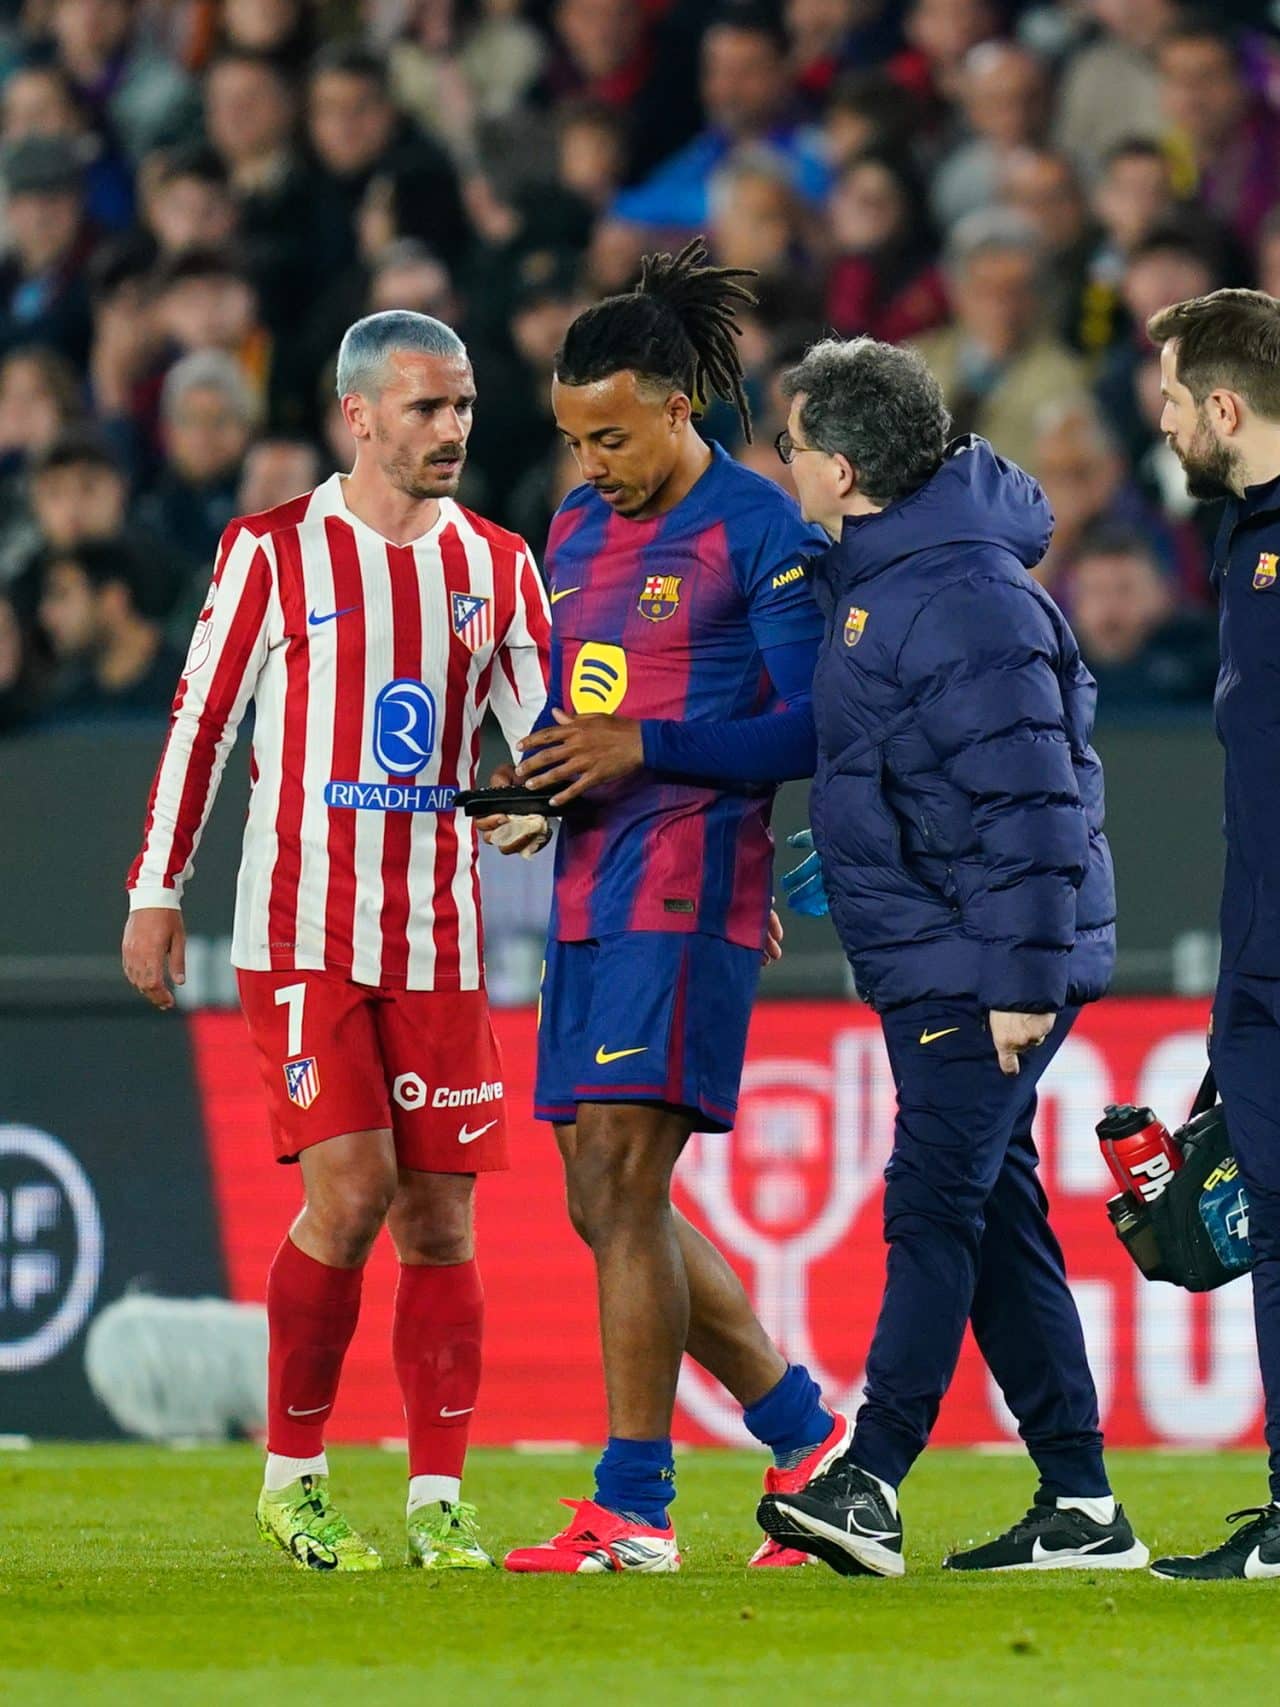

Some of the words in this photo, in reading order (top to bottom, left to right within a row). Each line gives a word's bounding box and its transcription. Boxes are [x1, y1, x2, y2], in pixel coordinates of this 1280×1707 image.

[772, 565, 805, 590] AMBI
[331, 783, 420, 809] RIYADH
[432, 1081, 503, 1108] ComAve
